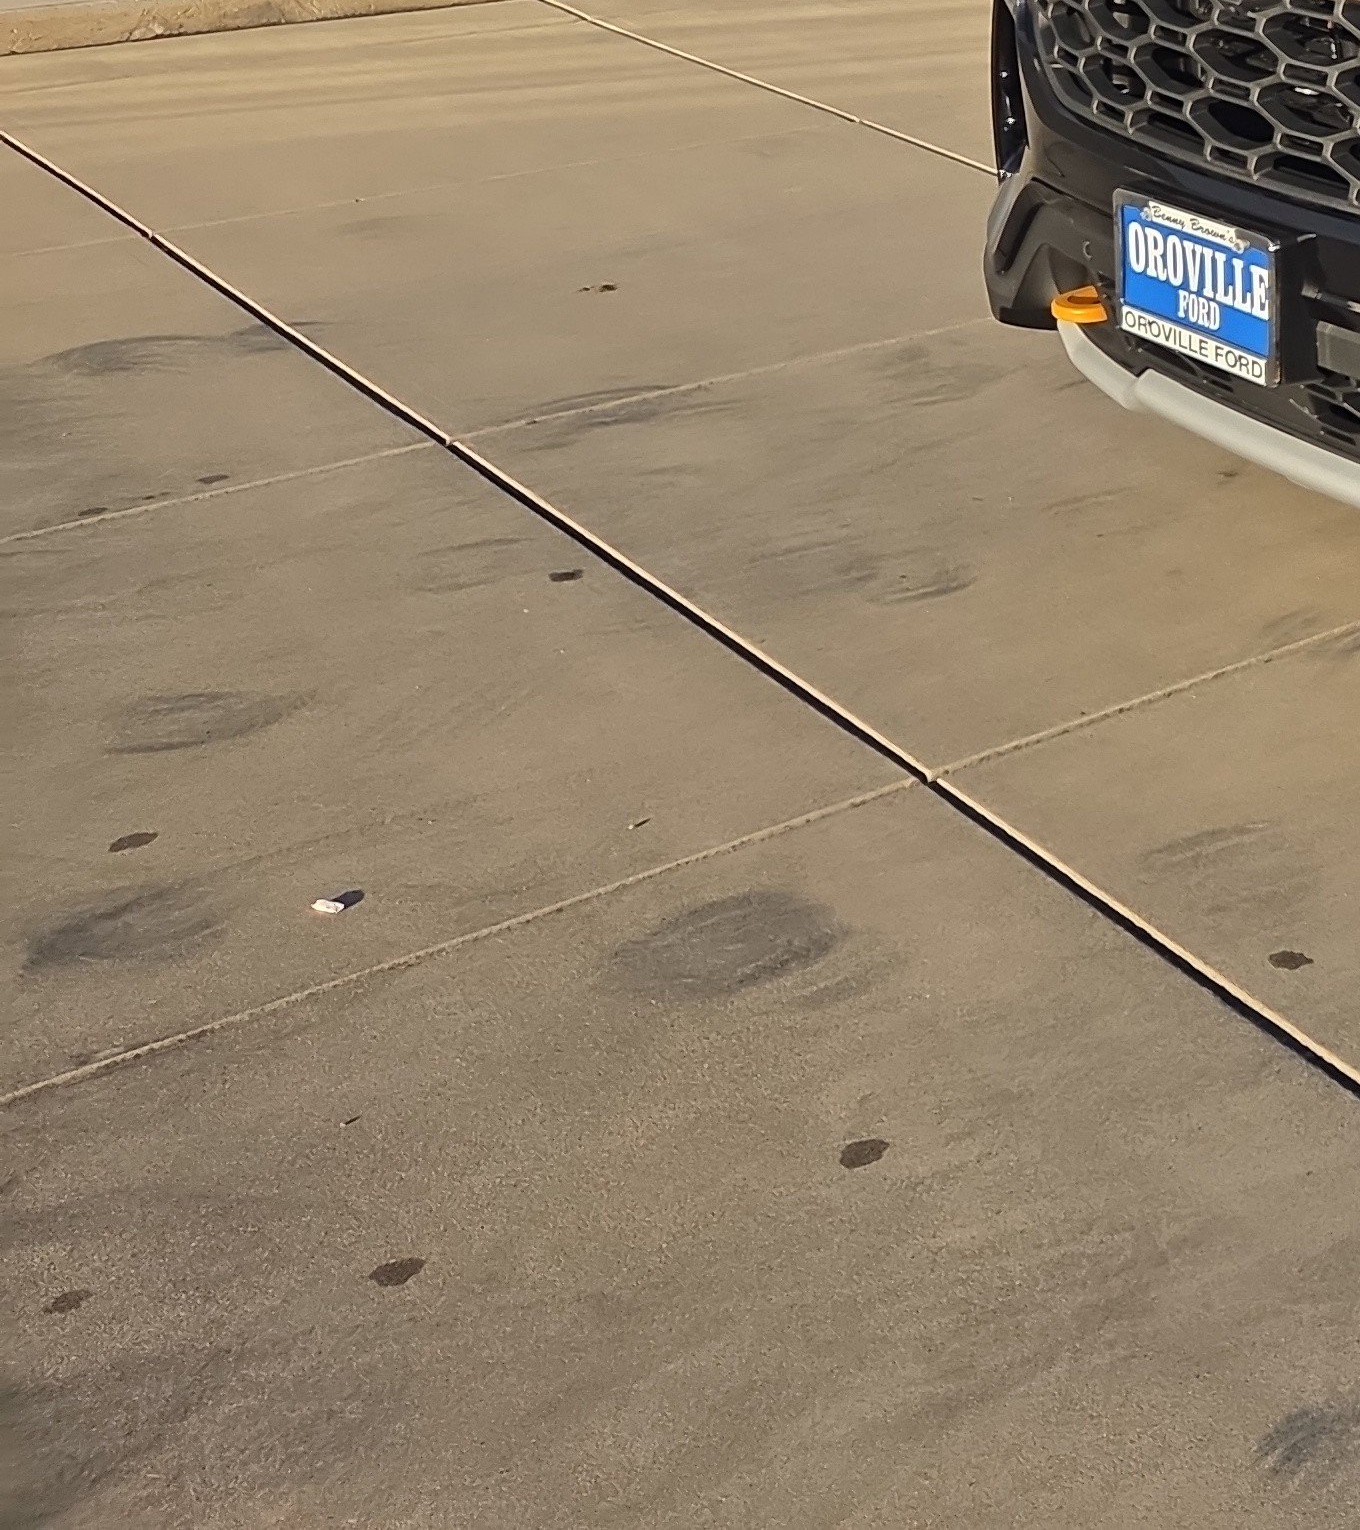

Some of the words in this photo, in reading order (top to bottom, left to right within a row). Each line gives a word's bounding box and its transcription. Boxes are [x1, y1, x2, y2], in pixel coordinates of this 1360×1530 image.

[1151, 205, 1186, 230] Benny
[1190, 217, 1236, 245] Brown's
[1128, 221, 1269, 321] OROVILLE
[1177, 289, 1221, 331] FORD
[1124, 310, 1209, 359] OROVILLE
[1214, 345, 1263, 379] FORD
